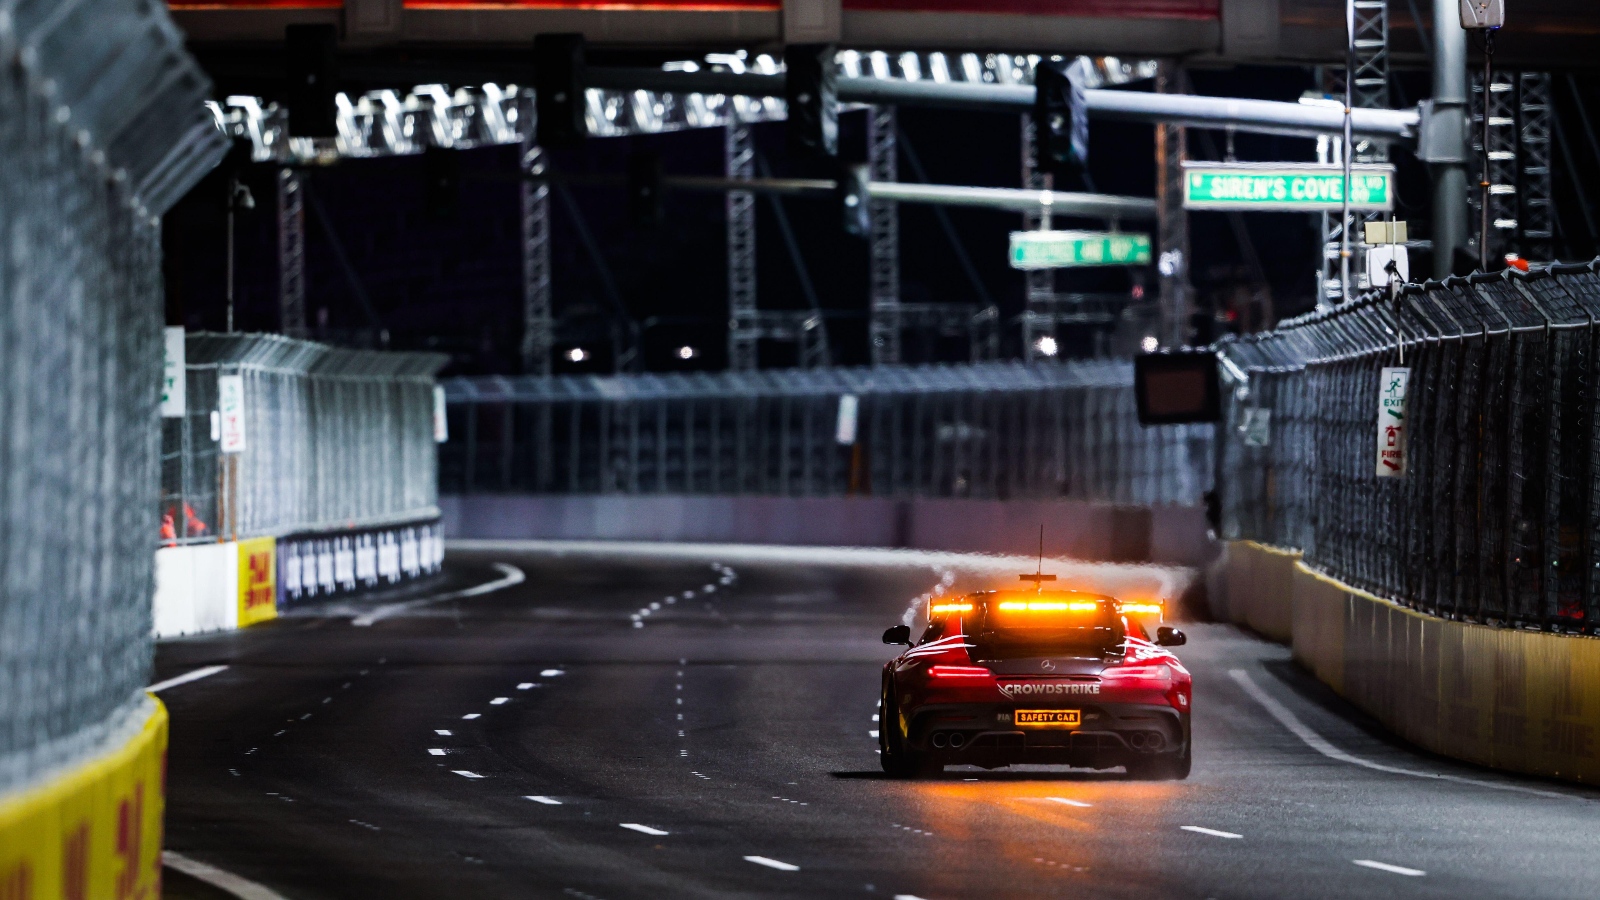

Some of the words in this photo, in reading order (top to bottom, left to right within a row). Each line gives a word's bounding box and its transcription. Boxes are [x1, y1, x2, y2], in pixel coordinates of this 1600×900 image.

[1210, 176, 1287, 200] SIREN'S
[1291, 177, 1344, 200] COVE
[1383, 398, 1404, 407] EXIT
[1381, 450, 1402, 458] FIRE
[1005, 684, 1100, 694] CROWDSTRIKE
[1020, 713, 1054, 721] SAFETY
[1057, 713, 1075, 721] CAR
